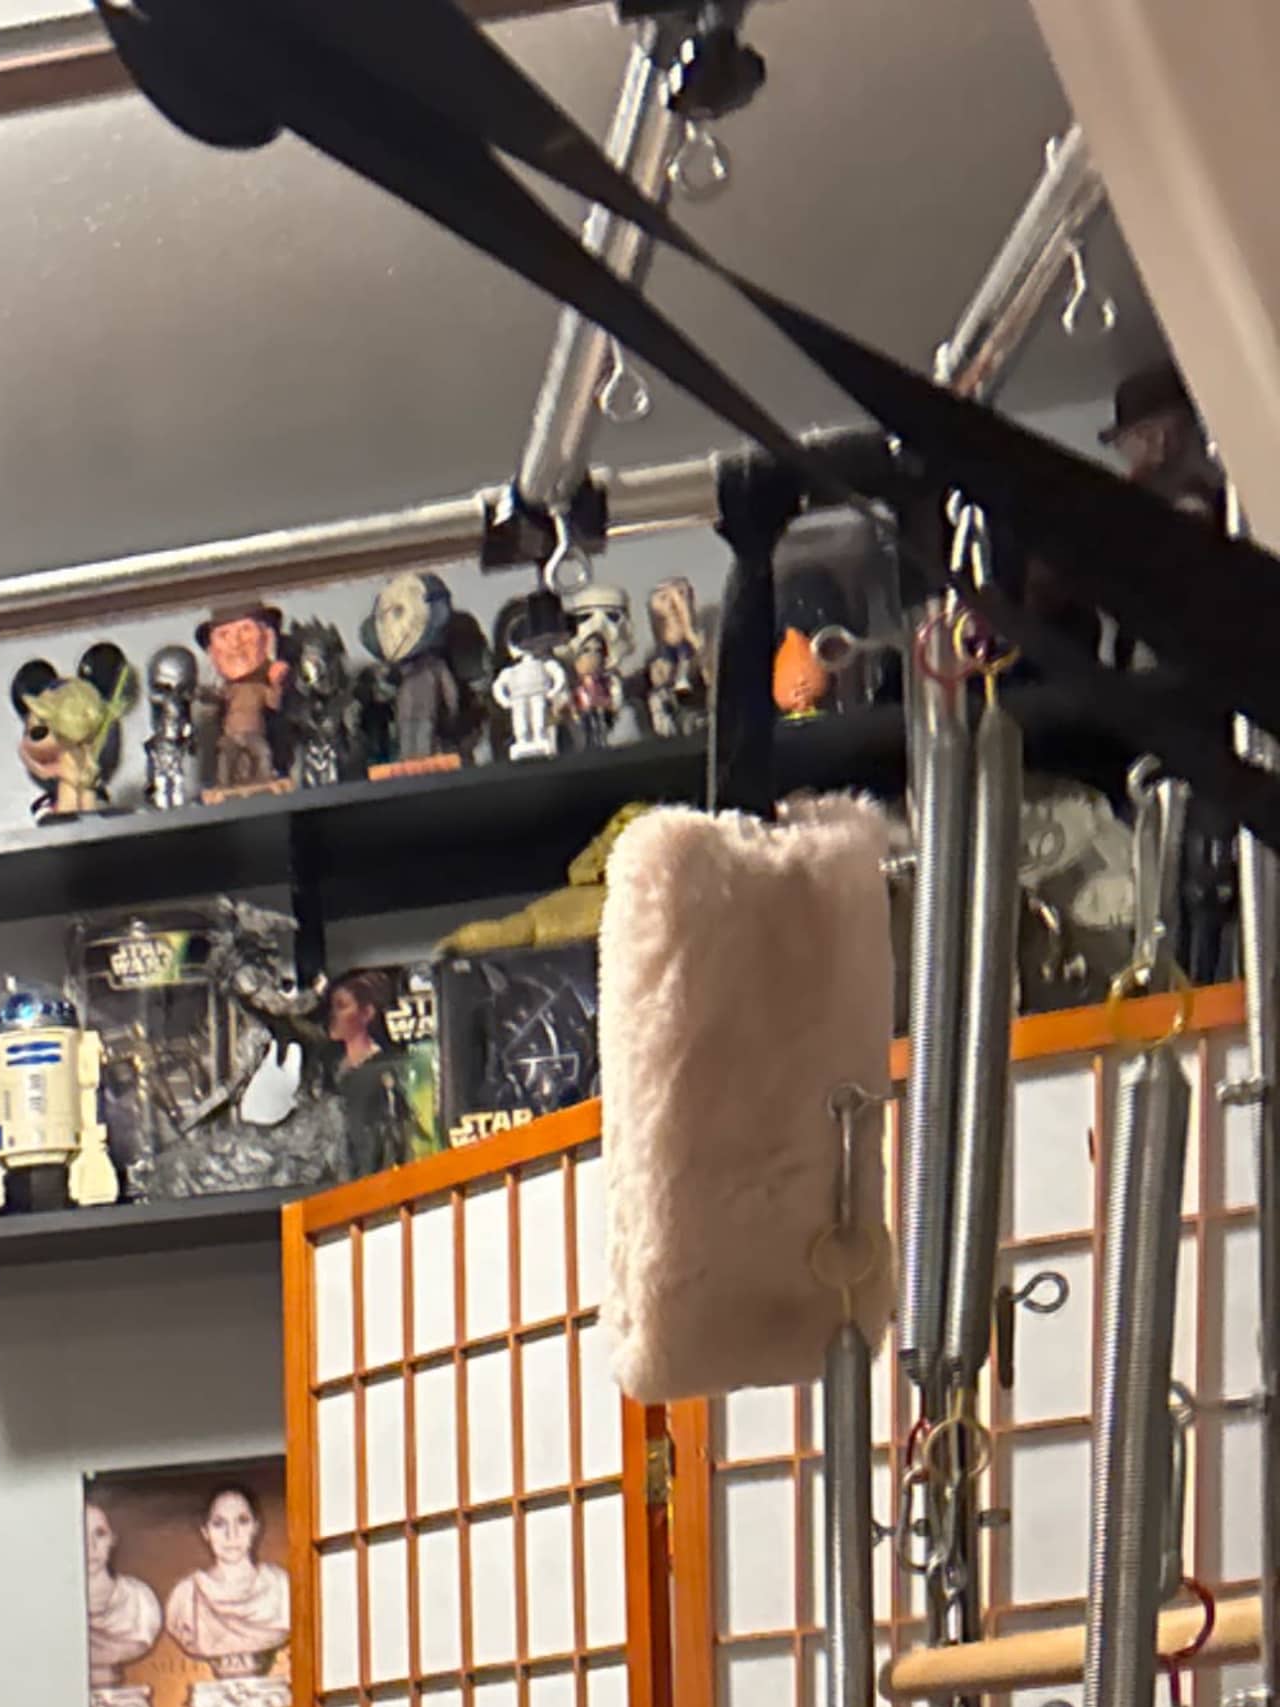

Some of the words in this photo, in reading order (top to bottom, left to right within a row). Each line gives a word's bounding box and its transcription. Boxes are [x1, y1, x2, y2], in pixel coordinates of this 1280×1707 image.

[385, 996, 434, 1024] ST
[388, 1016, 434, 1041] WA
[449, 1108, 534, 1136] STAR
